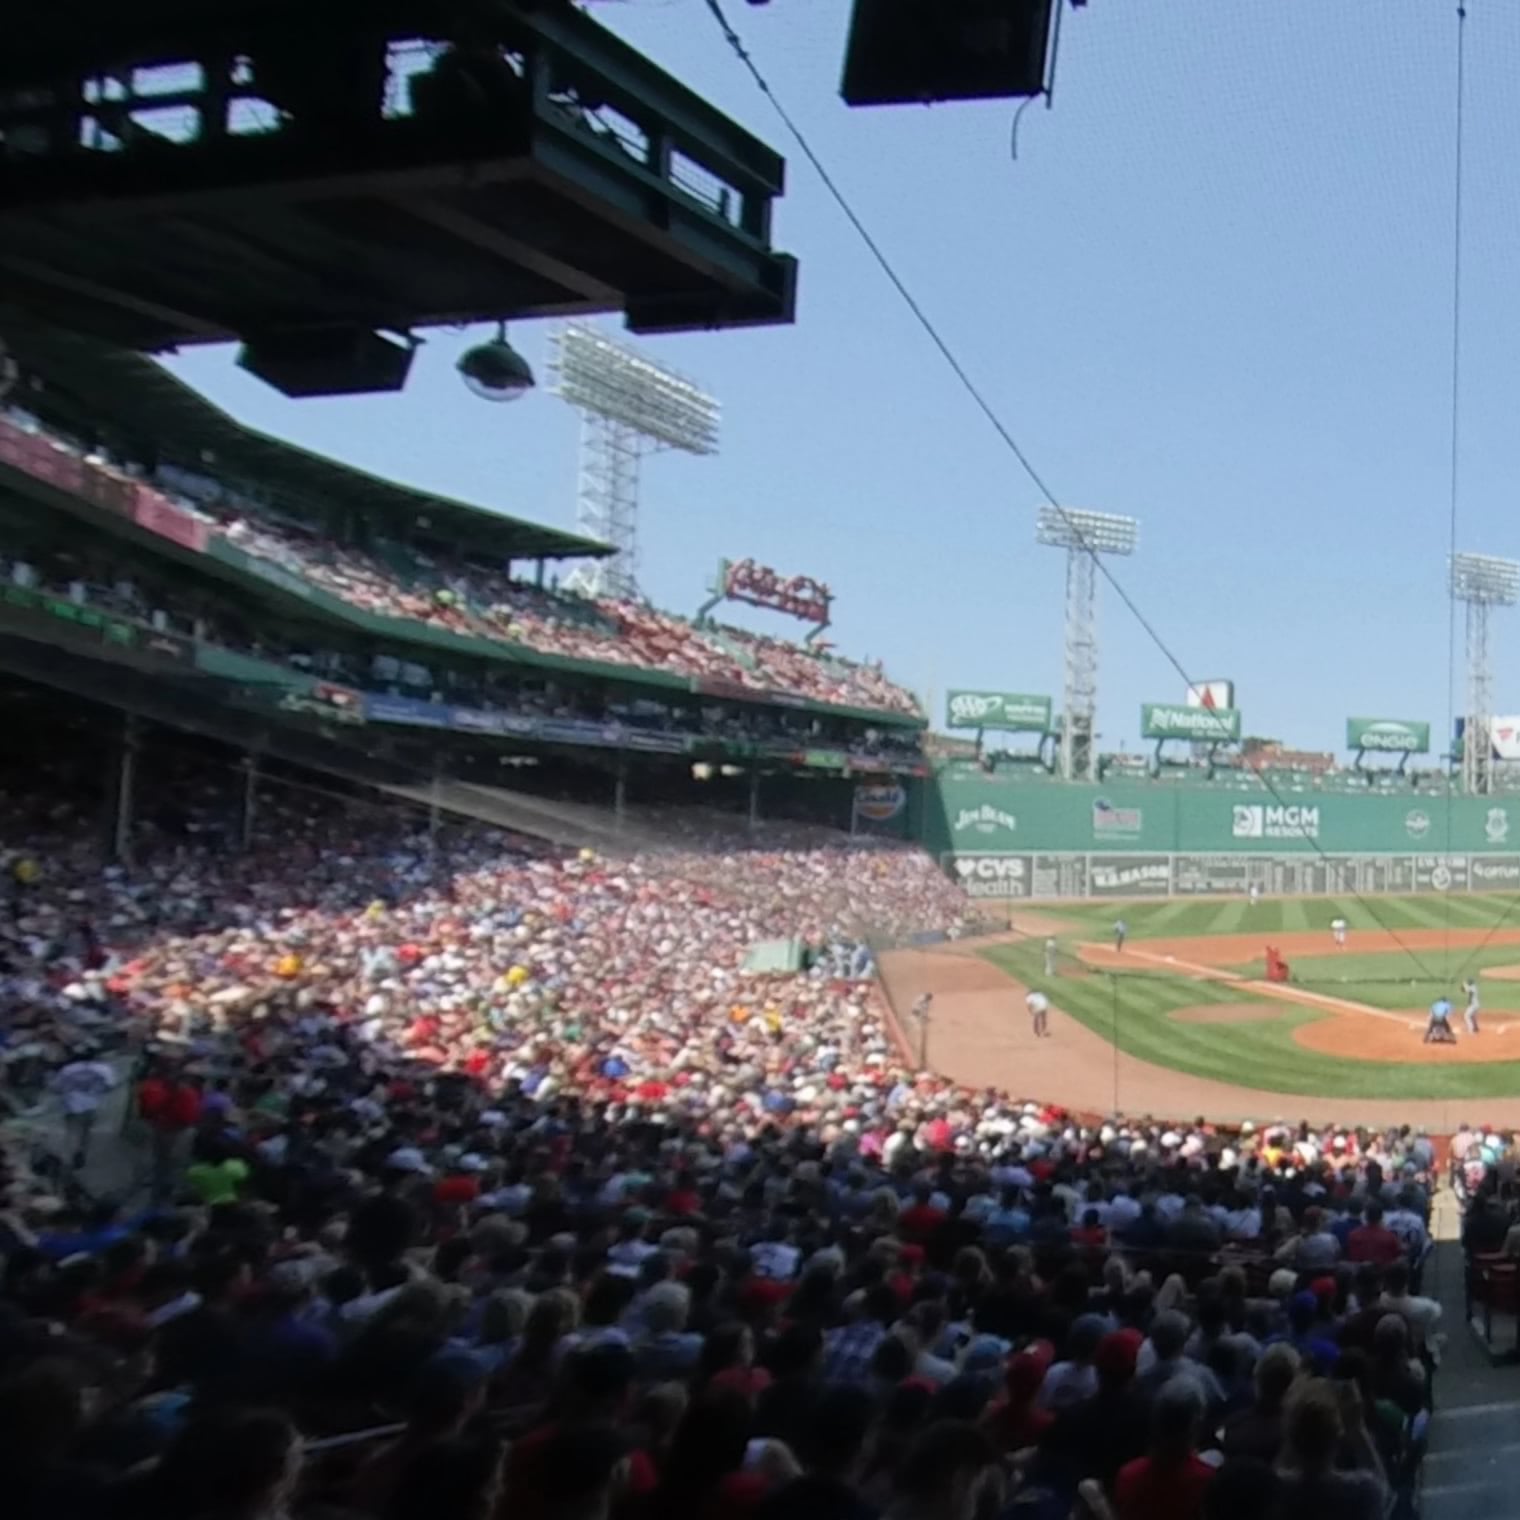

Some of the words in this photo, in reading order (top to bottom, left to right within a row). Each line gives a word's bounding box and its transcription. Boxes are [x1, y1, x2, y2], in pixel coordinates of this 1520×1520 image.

[1170, 711, 1235, 731] National
[1265, 805, 1319, 826] MGM
[976, 858, 1024, 877] CVS
